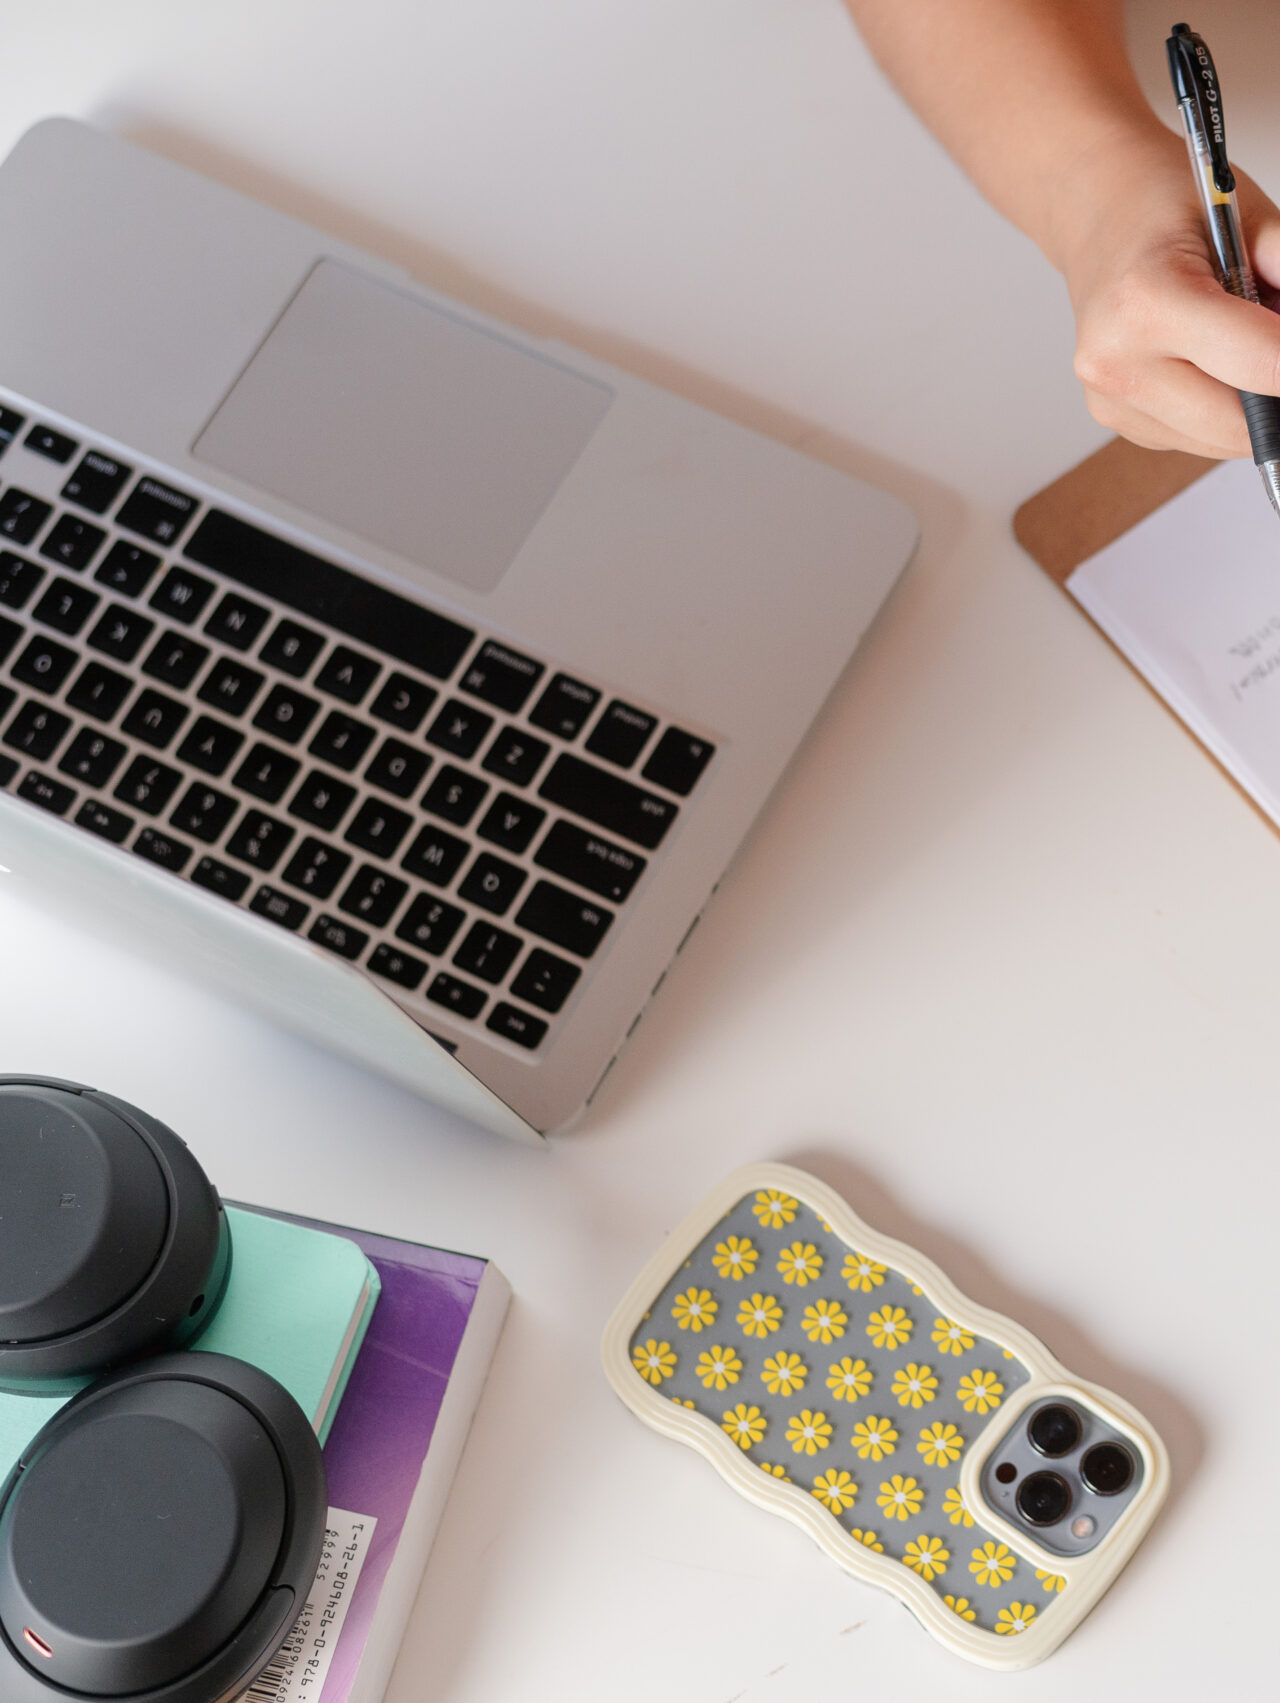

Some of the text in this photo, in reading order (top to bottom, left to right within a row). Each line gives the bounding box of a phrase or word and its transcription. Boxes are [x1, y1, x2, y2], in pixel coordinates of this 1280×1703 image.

[1195, 46, 1224, 144] PILOT G-2 05
[84, 454, 118, 476] option
[140, 480, 191, 511] command
[171, 584, 193, 604] M
[60, 595, 74, 615] L
[227, 610, 246, 631] N
[112, 622, 129, 642] K
[283, 638, 300, 657] B
[33, 654, 53, 673] O
[167, 649, 184, 668] J
[485, 646, 536, 676] command
[337, 665, 353, 684] V
[220, 676, 240, 696] H
[559, 681, 594, 704] option
[393, 691, 411, 711] C
[144, 708, 163, 728] U
[276, 702, 294, 723] G
[450, 718, 467, 738] X
[201, 737, 215, 755] Y
[333, 730, 349, 749] F
[505, 745, 524, 765] Z
[257, 764, 272, 782] T
[388, 757, 407, 777] D
[313, 790, 330, 809] R
[447, 785, 463, 804] S
[370, 817, 386, 837] E
[504, 812, 521, 831] A
[33, 714, 498, 951] 1 2 3 4 5 6 7 8 9
[423, 844, 445, 866] W
[482, 872, 500, 892] Q
[316, 1530, 340, 1581] 52999
[301, 1523, 364, 1687] 978-0-924608-26-1
